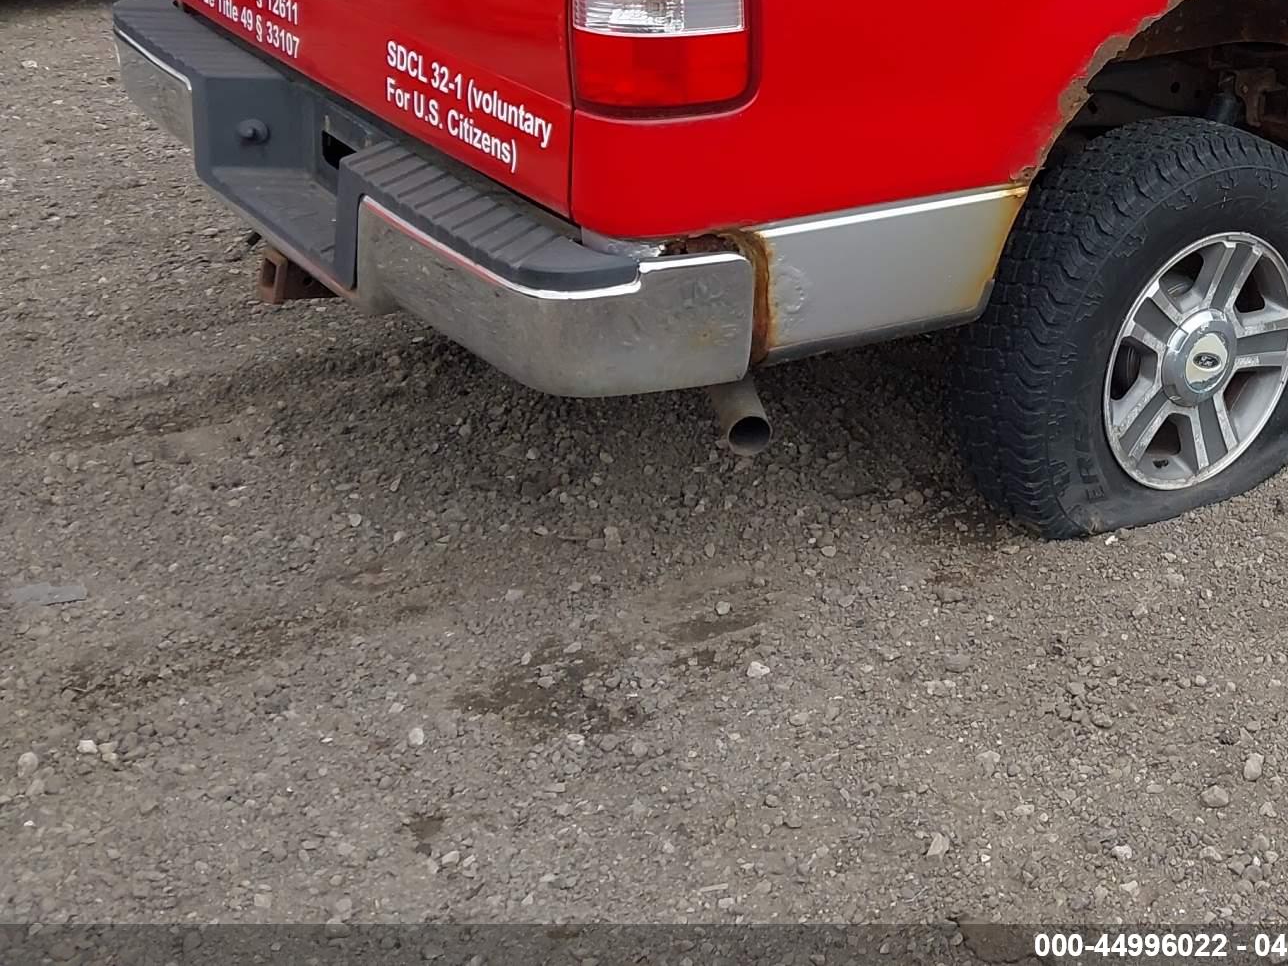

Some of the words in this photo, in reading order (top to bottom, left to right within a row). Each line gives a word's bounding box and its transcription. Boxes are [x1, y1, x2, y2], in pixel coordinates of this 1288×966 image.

[240, 7, 253, 31] 49
[256, 14, 263, 42] §
[266, 21, 300, 58] 33107
[386, 77, 410, 111] For
[413, 90, 443, 129] U.S.
[447, 109, 517, 173] Citizens)
[387, 40, 428, 83] SDCL
[431, 62, 462, 100] 32-1
[467, 79, 552, 148] (voluntary
